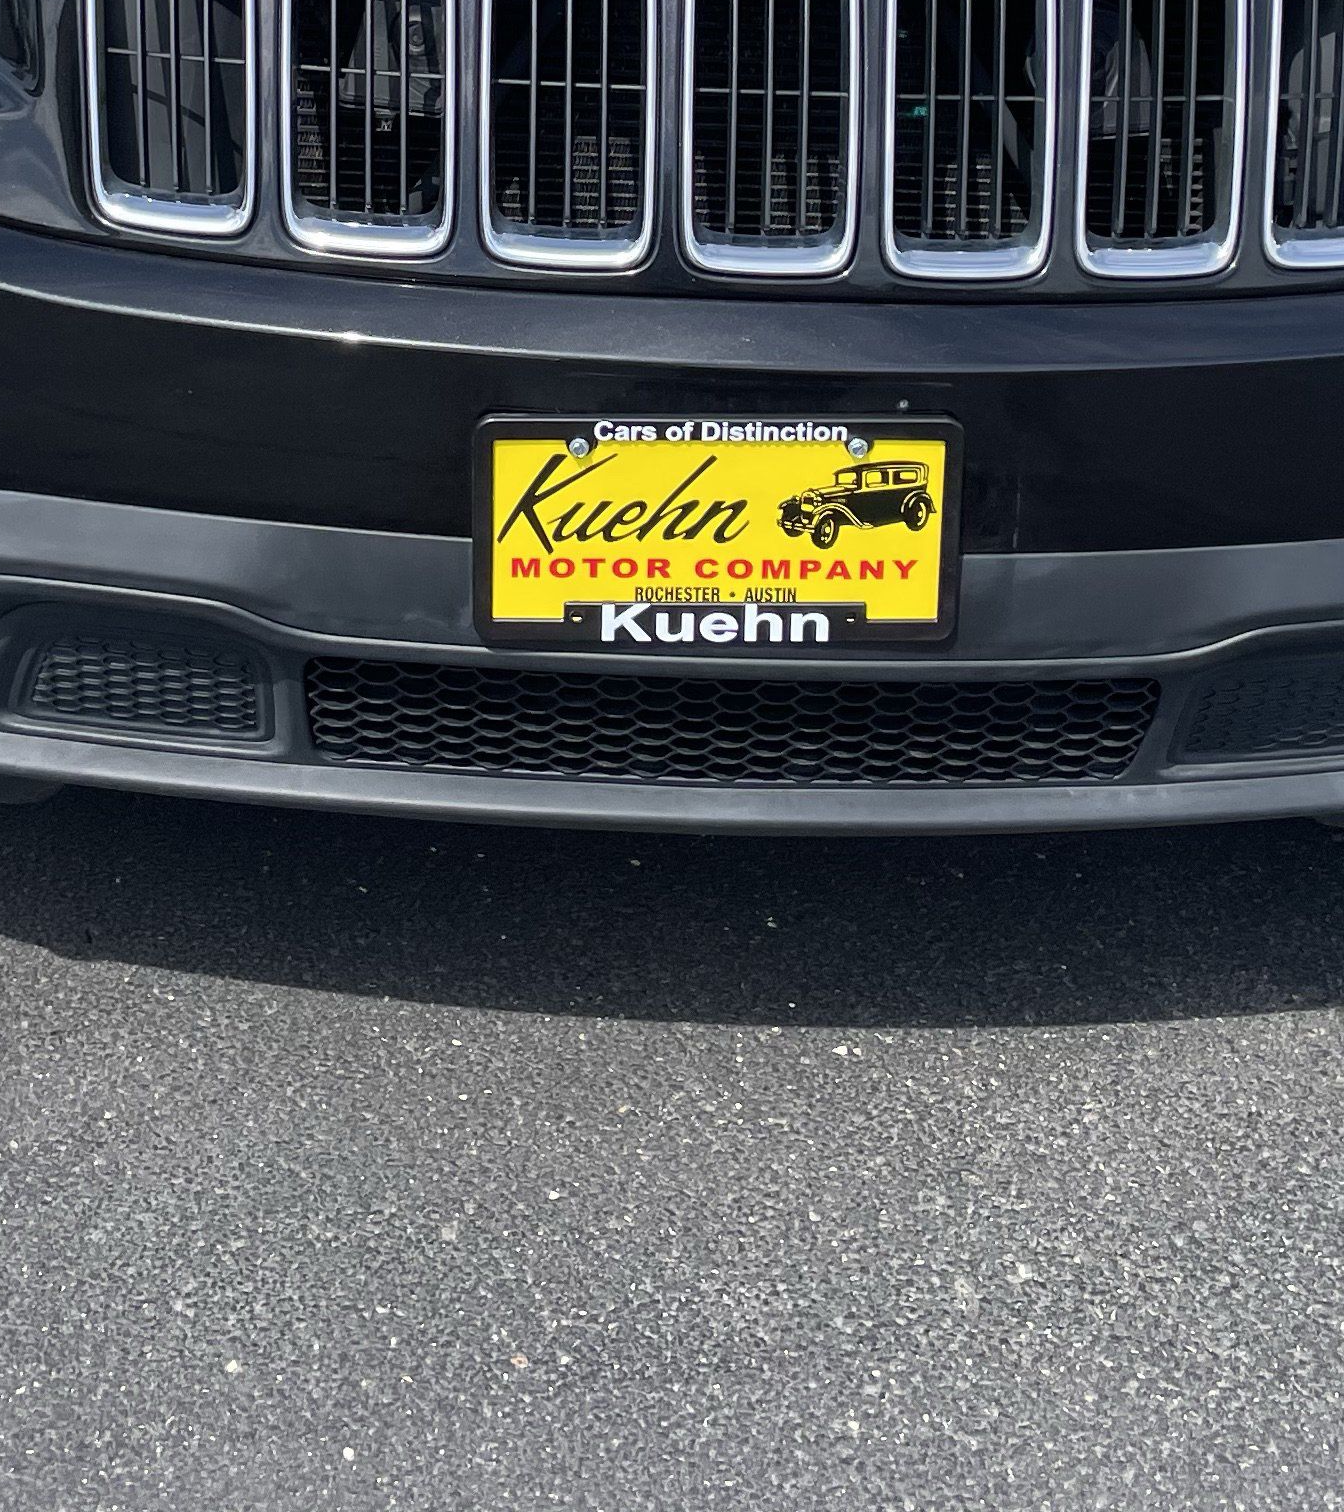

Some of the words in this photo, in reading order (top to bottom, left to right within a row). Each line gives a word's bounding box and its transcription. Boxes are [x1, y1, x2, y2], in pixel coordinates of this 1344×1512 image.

[593, 420, 662, 442] Cars
[666, 420, 695, 442] of
[701, 420, 848, 443] Distinction
[496, 452, 751, 555] Kuehn
[510, 556, 672, 579] MOTOR
[694, 557, 919, 581] COMPANY
[634, 585, 720, 603] ROCHESTER
[744, 586, 797, 603] AUSTIN
[599, 602, 831, 643] Kuehn
